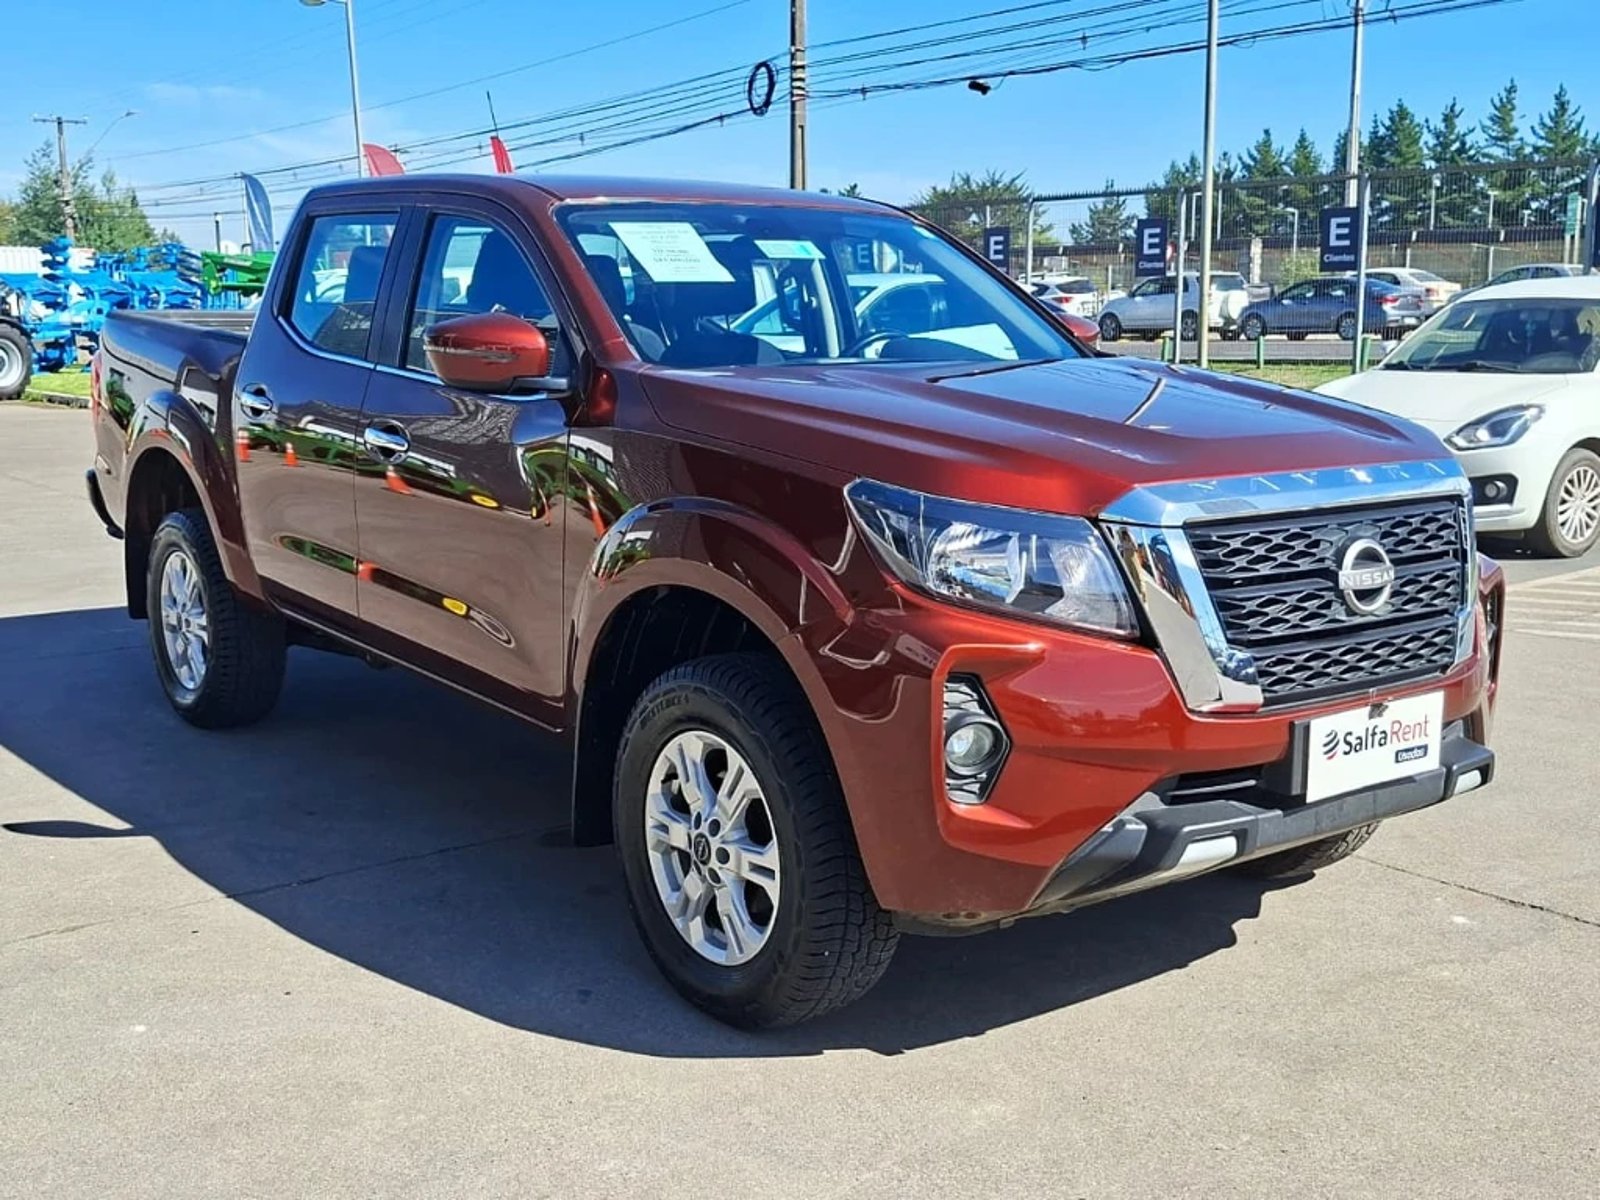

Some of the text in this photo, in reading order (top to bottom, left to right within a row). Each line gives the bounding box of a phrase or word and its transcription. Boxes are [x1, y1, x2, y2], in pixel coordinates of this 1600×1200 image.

[1143, 226, 1161, 255] E
[1329, 215, 1351, 247] E
[989, 235, 1005, 260] E
[1322, 252, 1356, 264] Clientes
[1138, 260, 1165, 271] Clientes
[1341, 569, 1394, 588] NISSAN
[1343, 714, 1431, 756] SalfaRent
